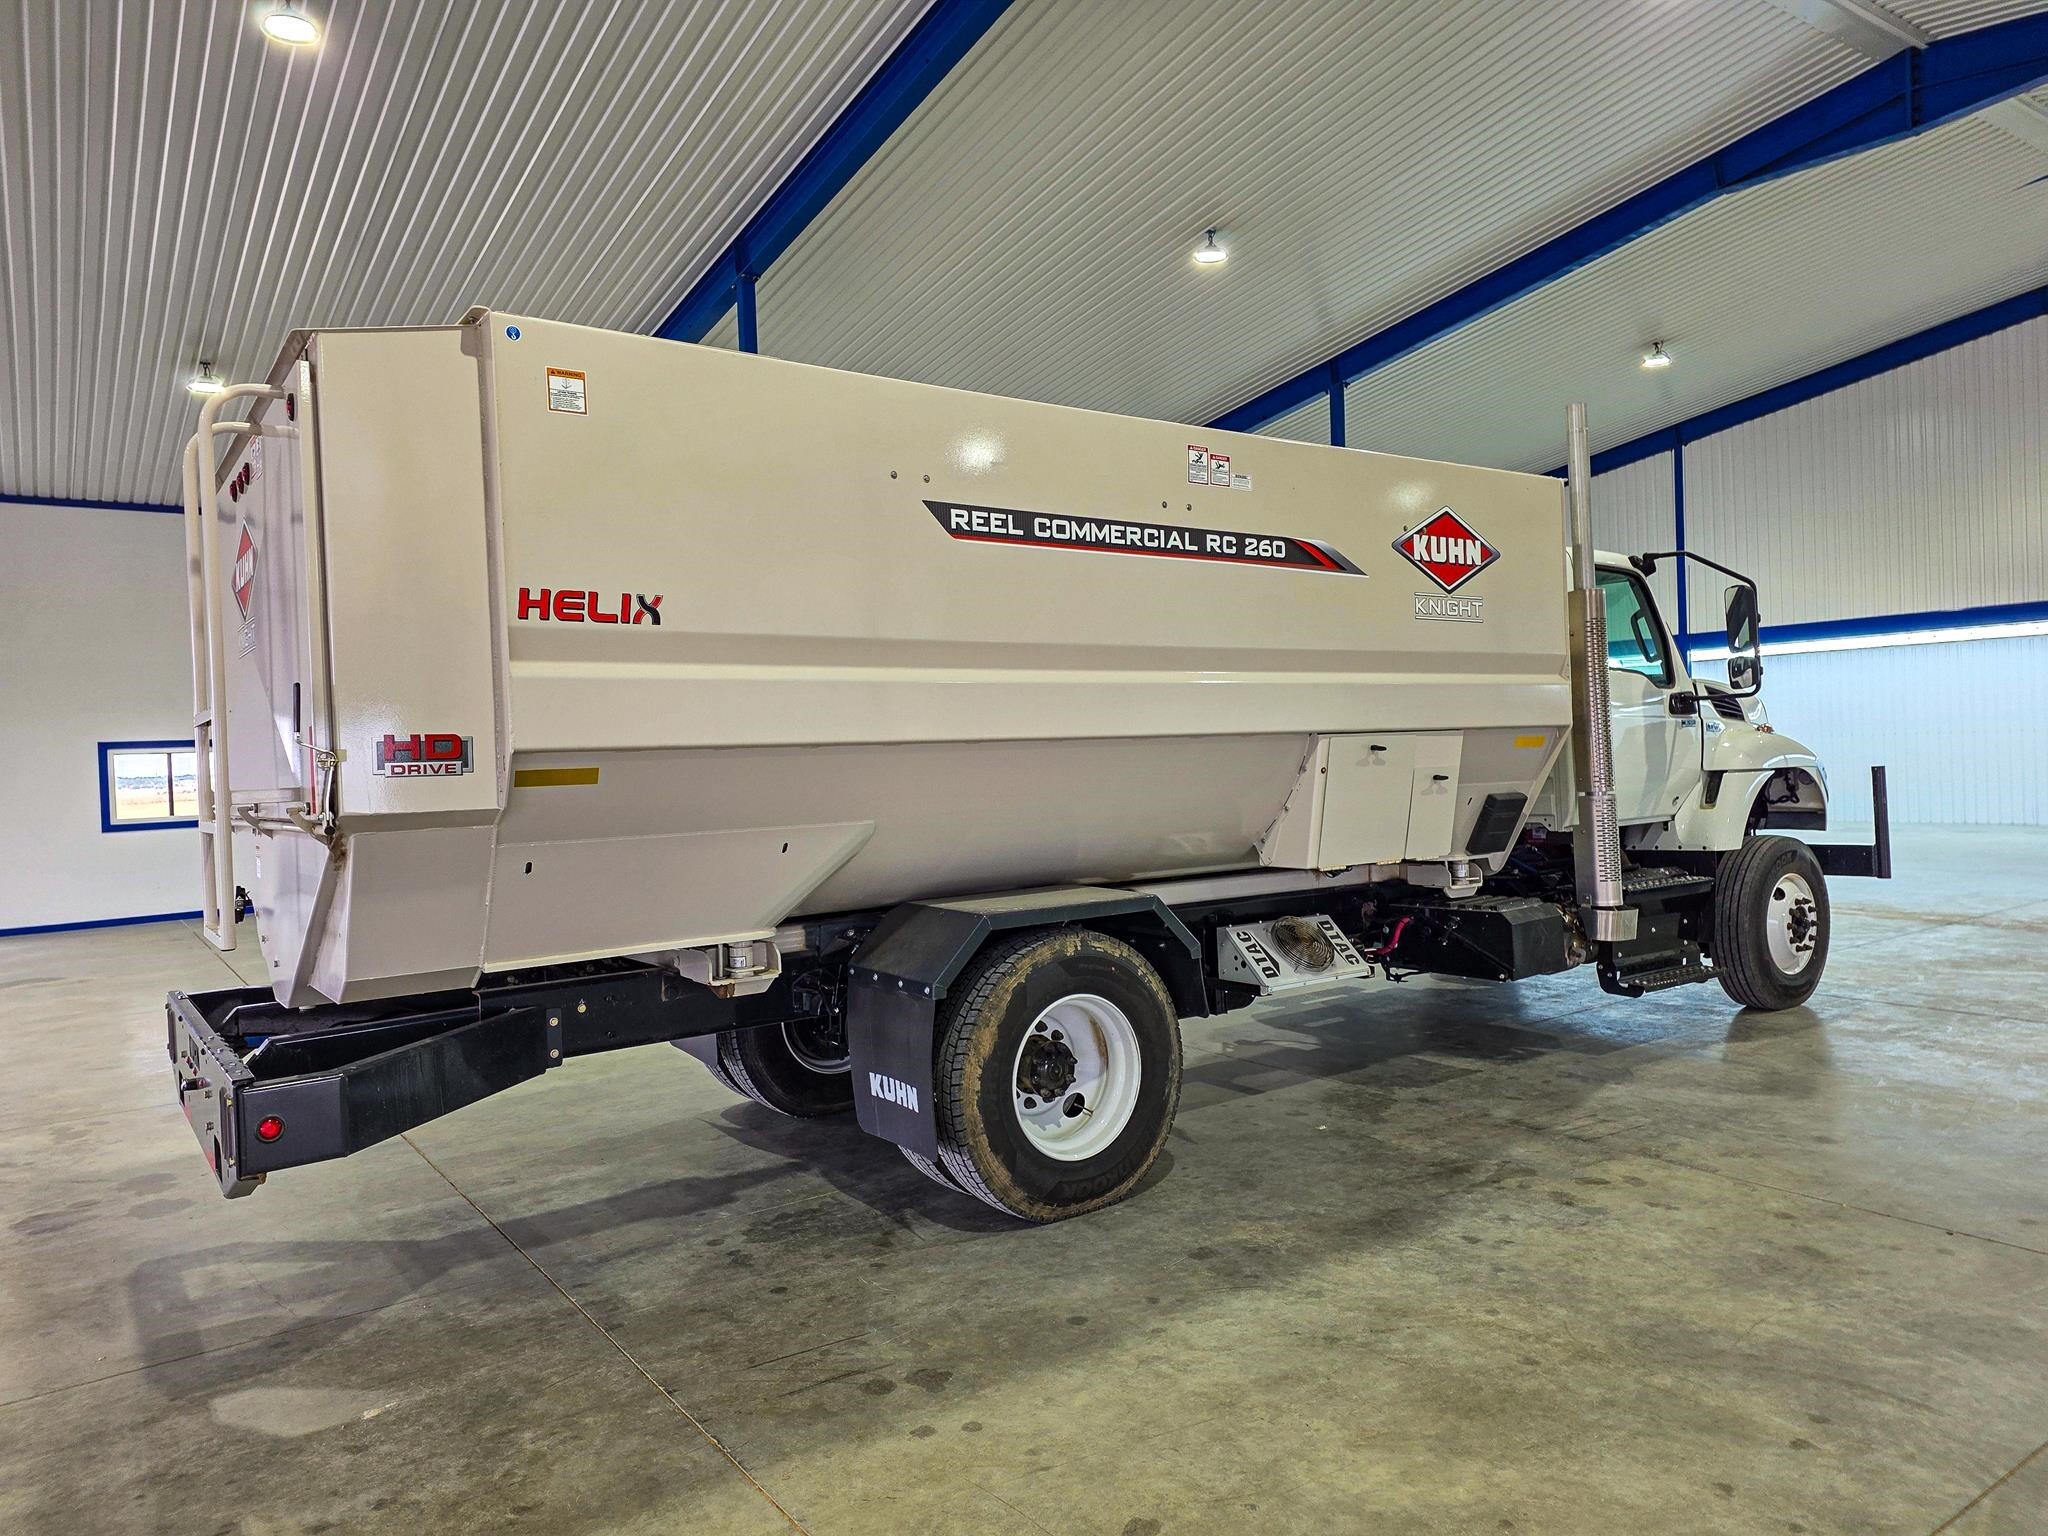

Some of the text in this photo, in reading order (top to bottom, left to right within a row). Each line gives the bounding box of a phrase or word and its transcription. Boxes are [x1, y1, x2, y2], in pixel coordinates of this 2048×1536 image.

[950, 508, 1286, 559] REEL COMMERCIAL RC 260
[1413, 533, 1482, 566] KUHN
[517, 588, 664, 625] HELIX
[1414, 597, 1483, 617] KNIGHT
[384, 734, 463, 762] HD
[390, 764, 457, 776] DRIVE
[1235, 931, 1280, 979] DTAC
[1317, 920, 1360, 966] DTAC
[868, 1071, 920, 1113] KUHN
